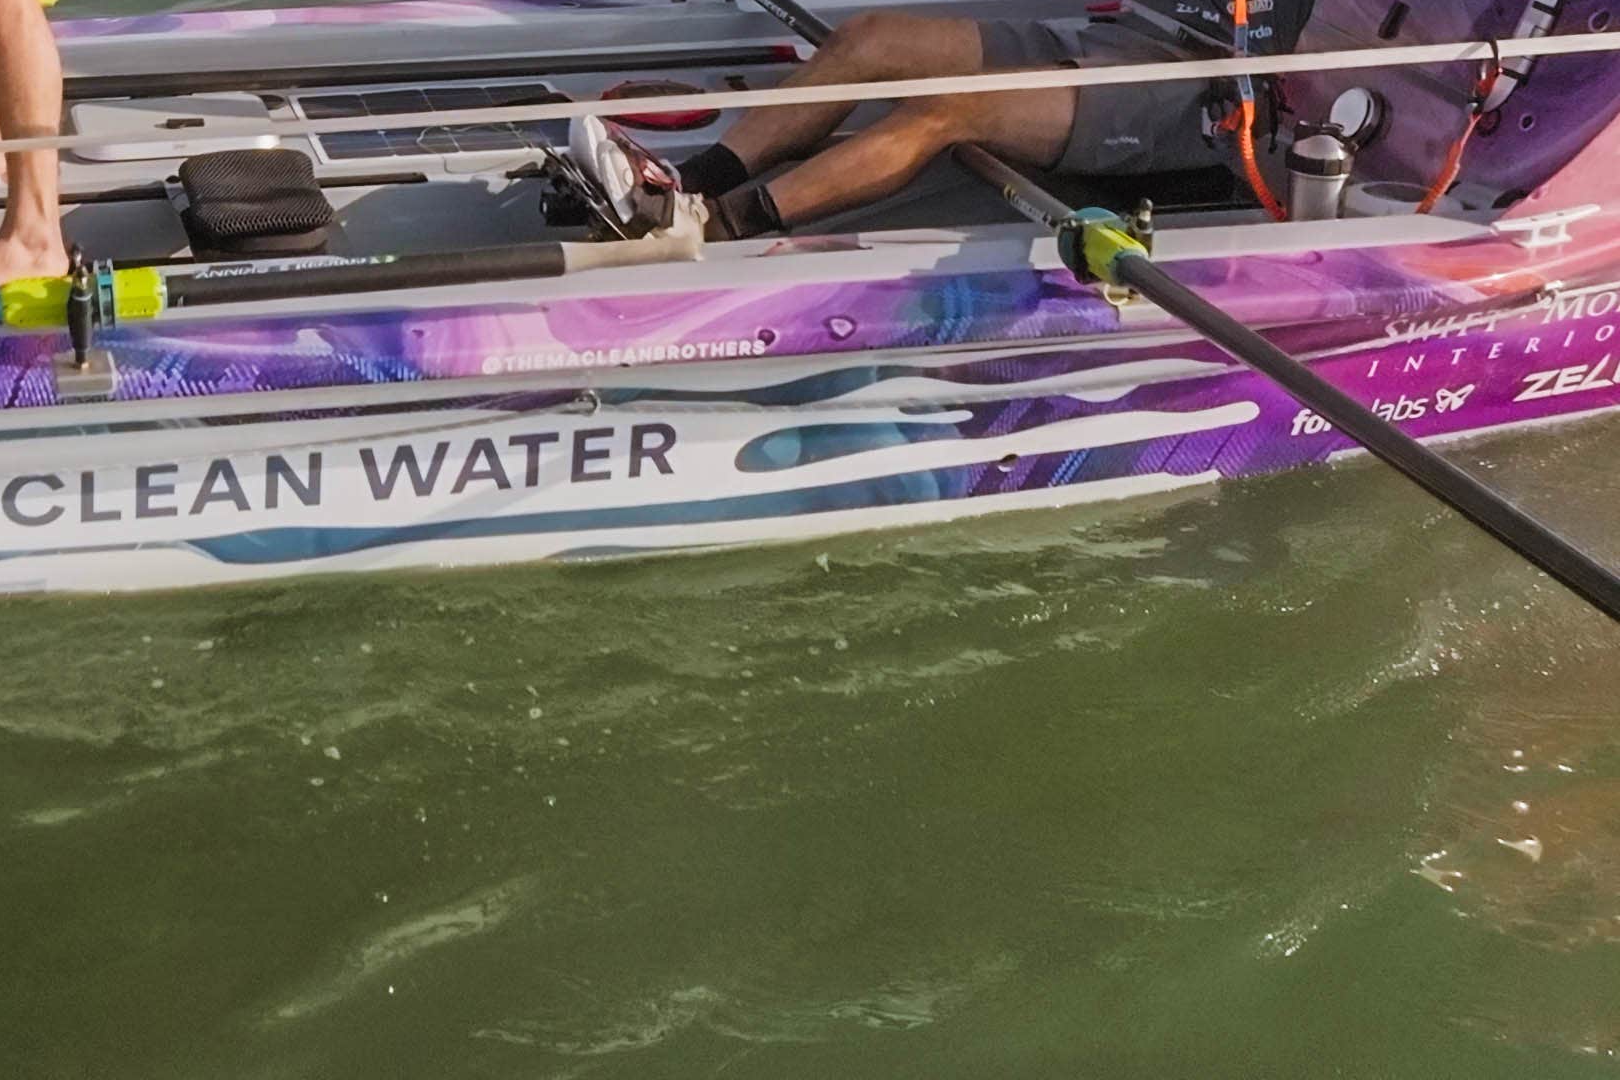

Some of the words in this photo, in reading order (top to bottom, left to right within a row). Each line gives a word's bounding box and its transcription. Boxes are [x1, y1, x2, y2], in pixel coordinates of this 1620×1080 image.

[1541, 291, 1620, 325] MO
[482, 340, 766, 374] @THEMACLEANBROTHERS
[1, 452, 322, 526] CLEAN
[358, 422, 676, 501] WATER
